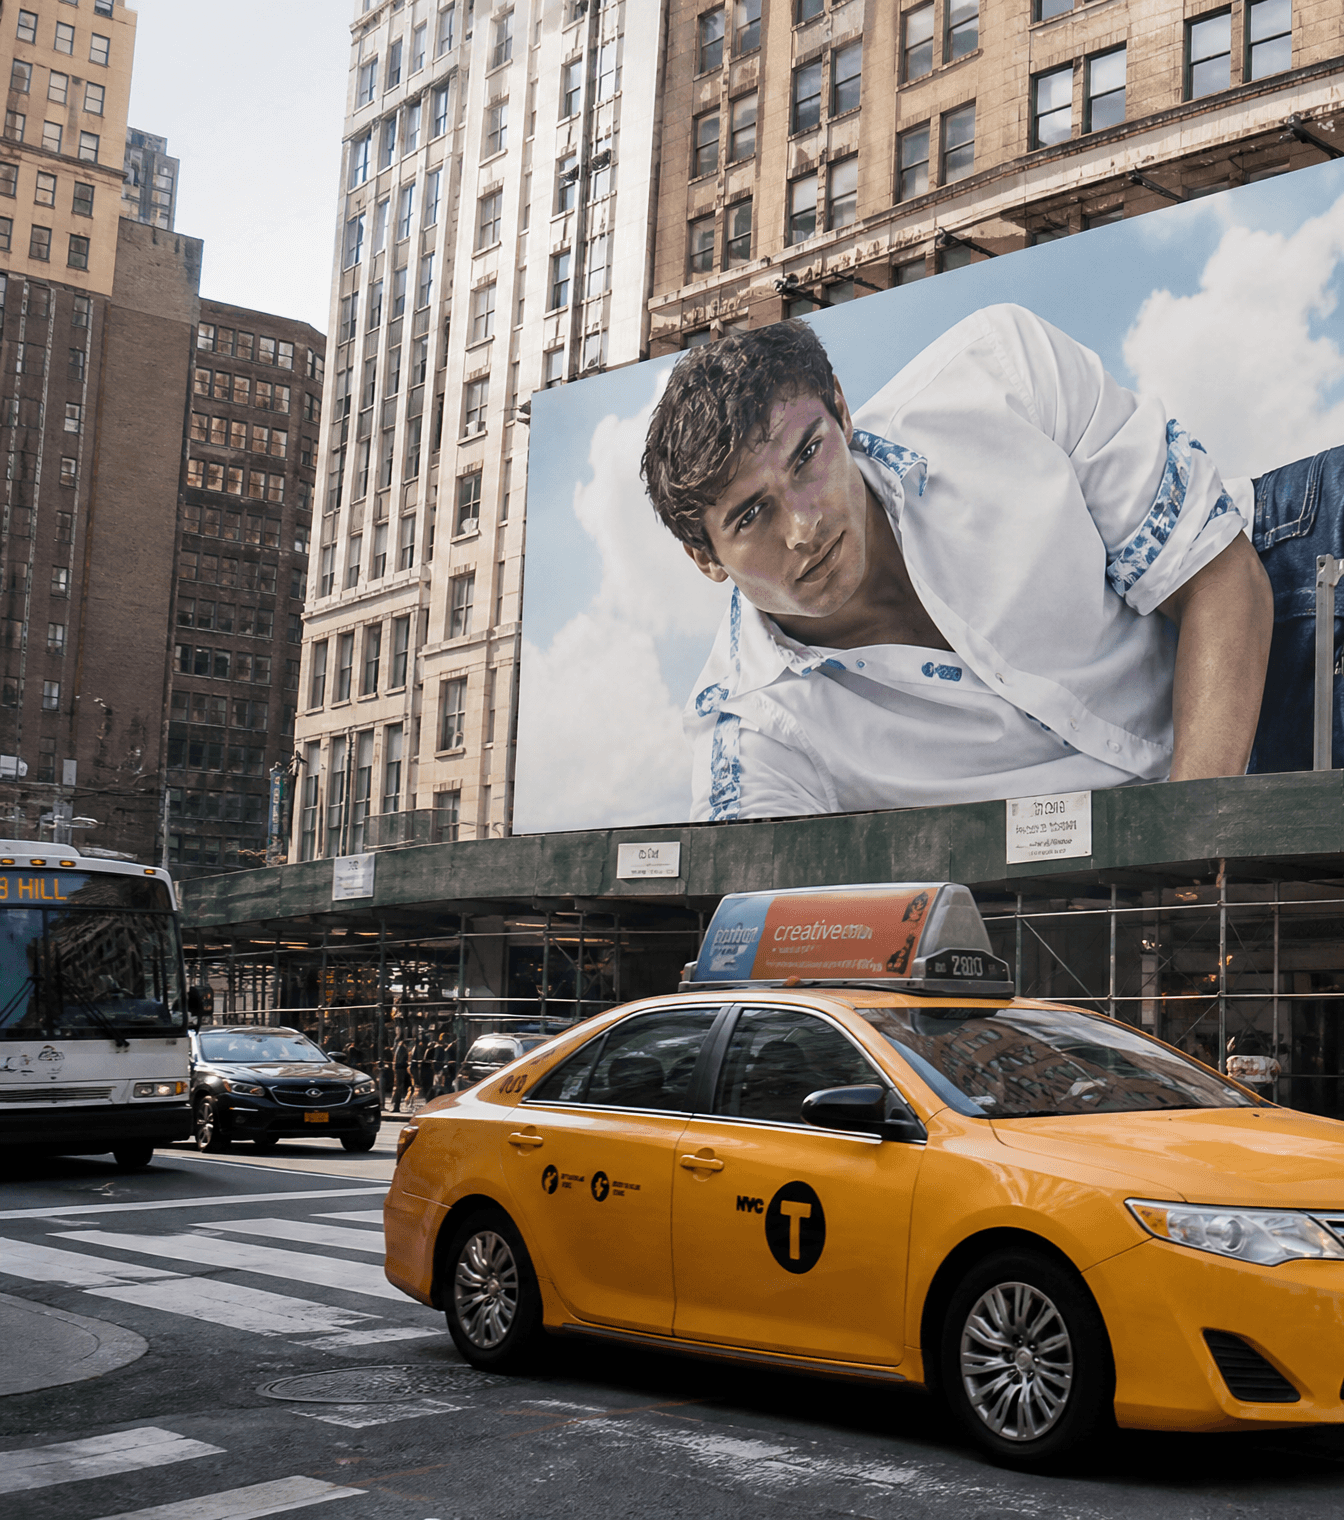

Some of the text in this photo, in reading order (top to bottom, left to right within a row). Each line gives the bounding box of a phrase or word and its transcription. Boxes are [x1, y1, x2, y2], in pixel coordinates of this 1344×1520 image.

[18, 877, 68, 900] HILL
[736, 1195, 812, 1260] NYC T
